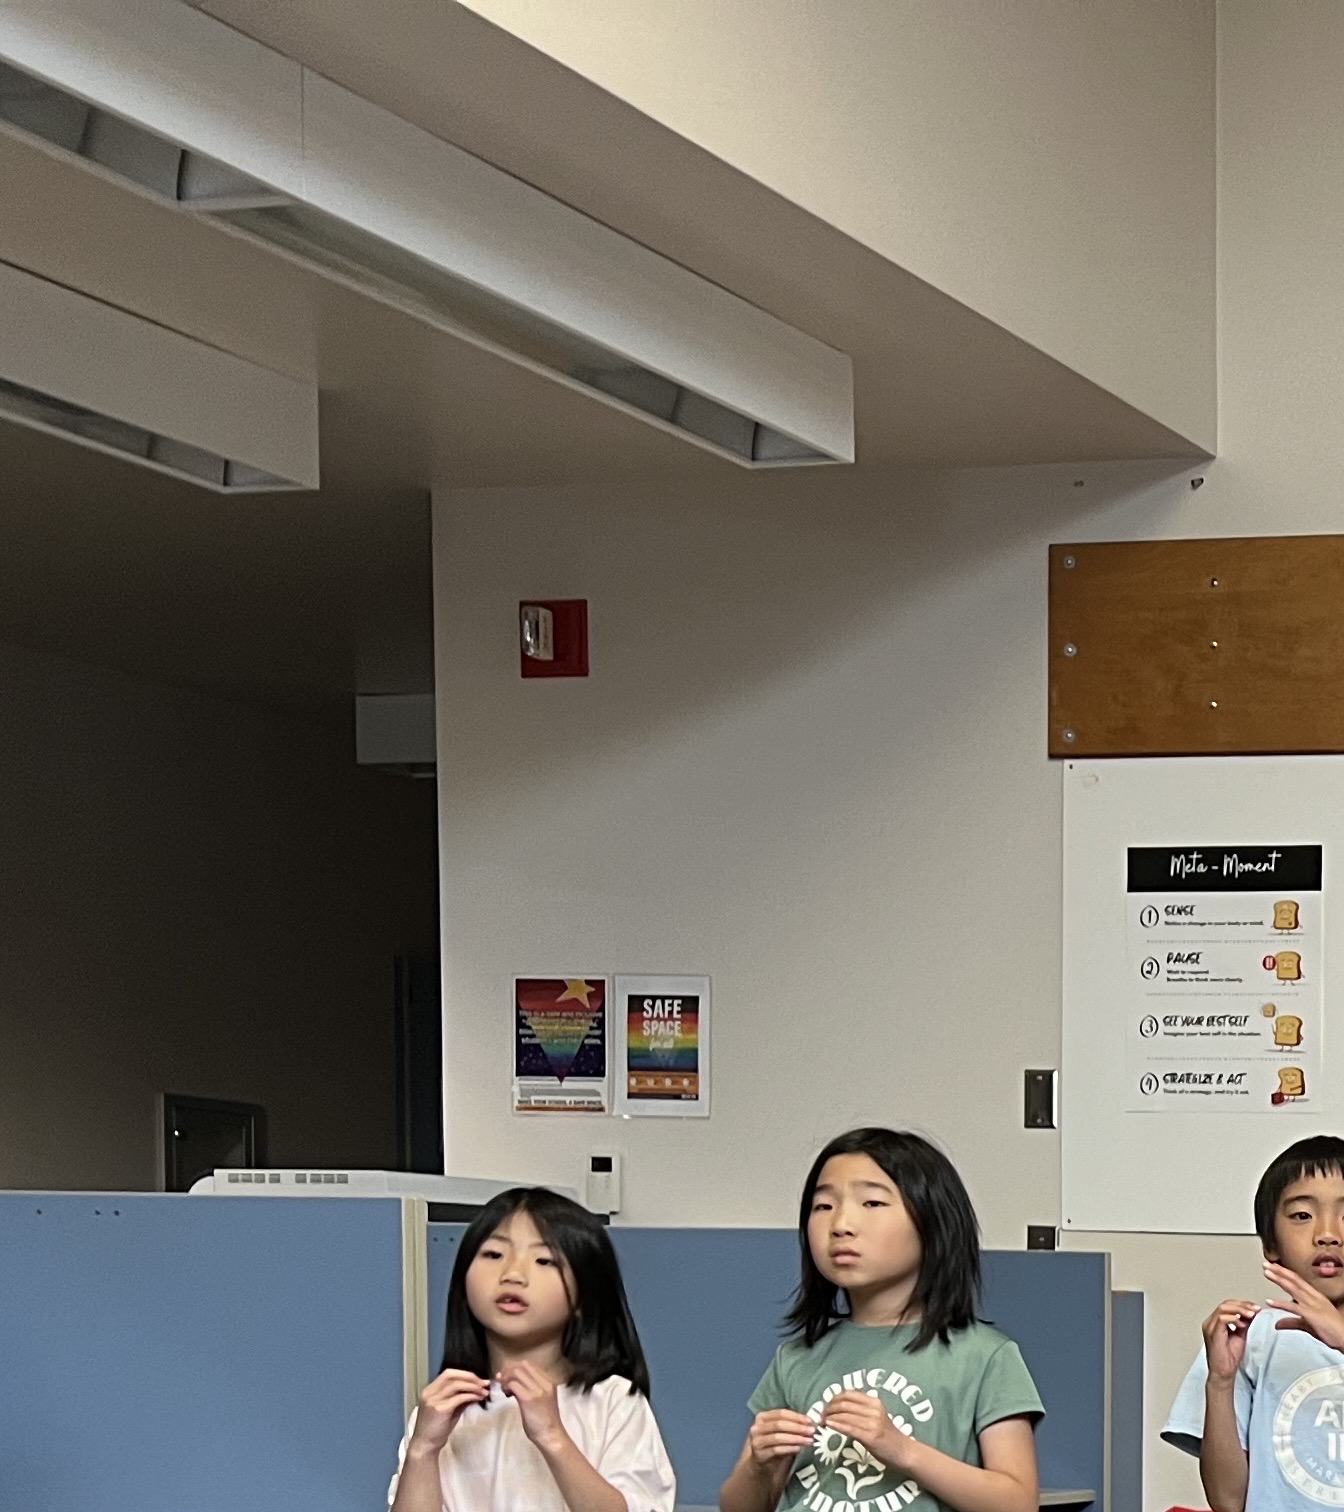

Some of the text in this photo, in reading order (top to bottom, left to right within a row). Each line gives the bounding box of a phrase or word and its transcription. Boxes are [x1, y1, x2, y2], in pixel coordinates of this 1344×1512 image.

[1169, 850, 1208, 879] Meta
[1223, 850, 1282, 879] Moment
[1166, 951, 1203, 965] PAUSE
[643, 998, 682, 1019] SAFE
[643, 1020, 682, 1037] SPACE
